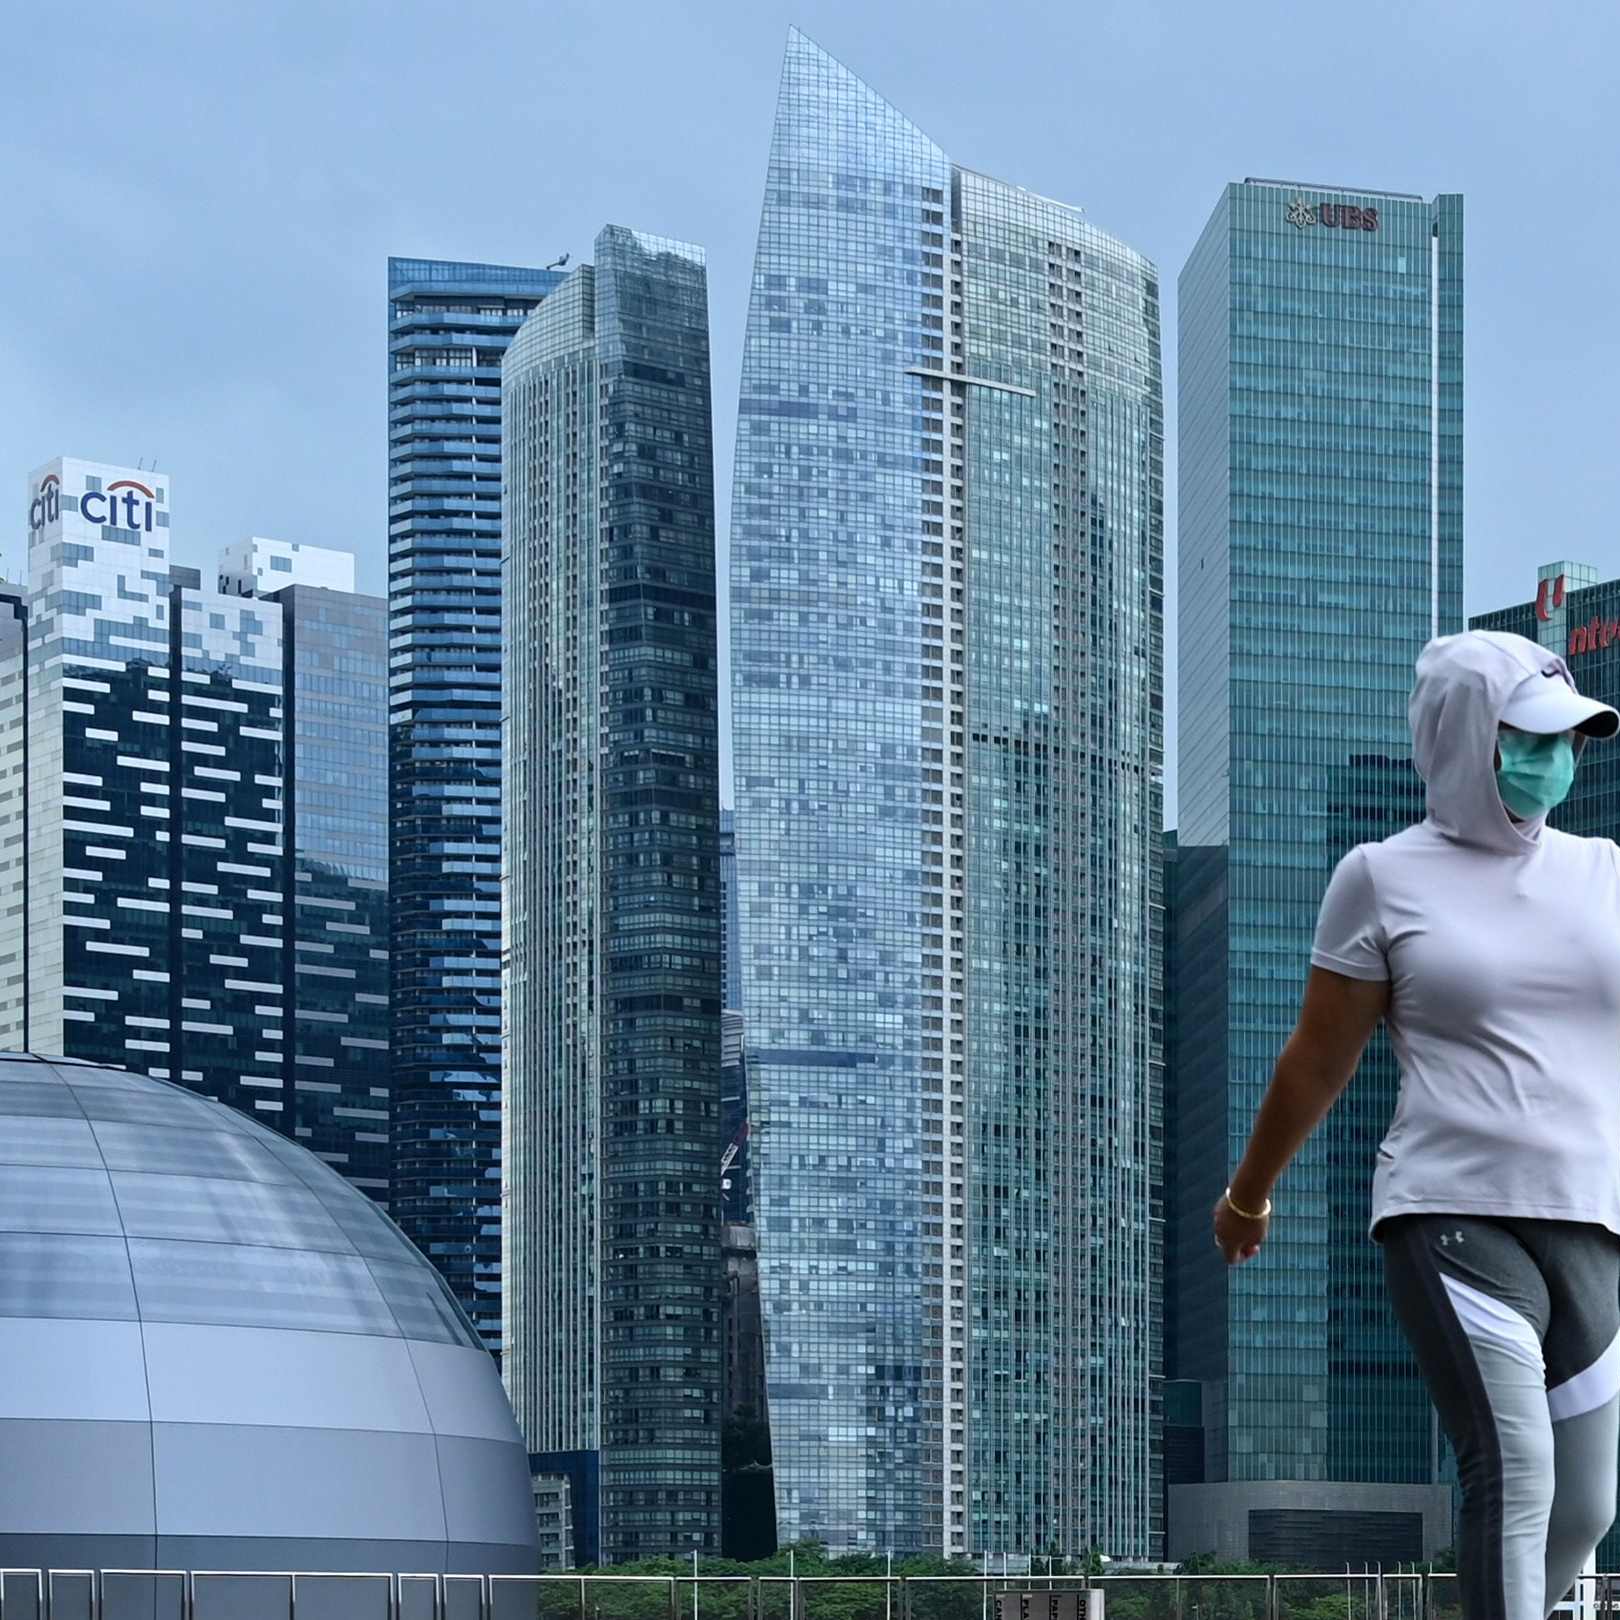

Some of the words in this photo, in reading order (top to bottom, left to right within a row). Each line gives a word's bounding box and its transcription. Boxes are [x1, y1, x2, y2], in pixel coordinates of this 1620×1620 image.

[1319, 202, 1377, 231] UBS
[30, 479, 60, 530] citi
[80, 484, 154, 533] citi
